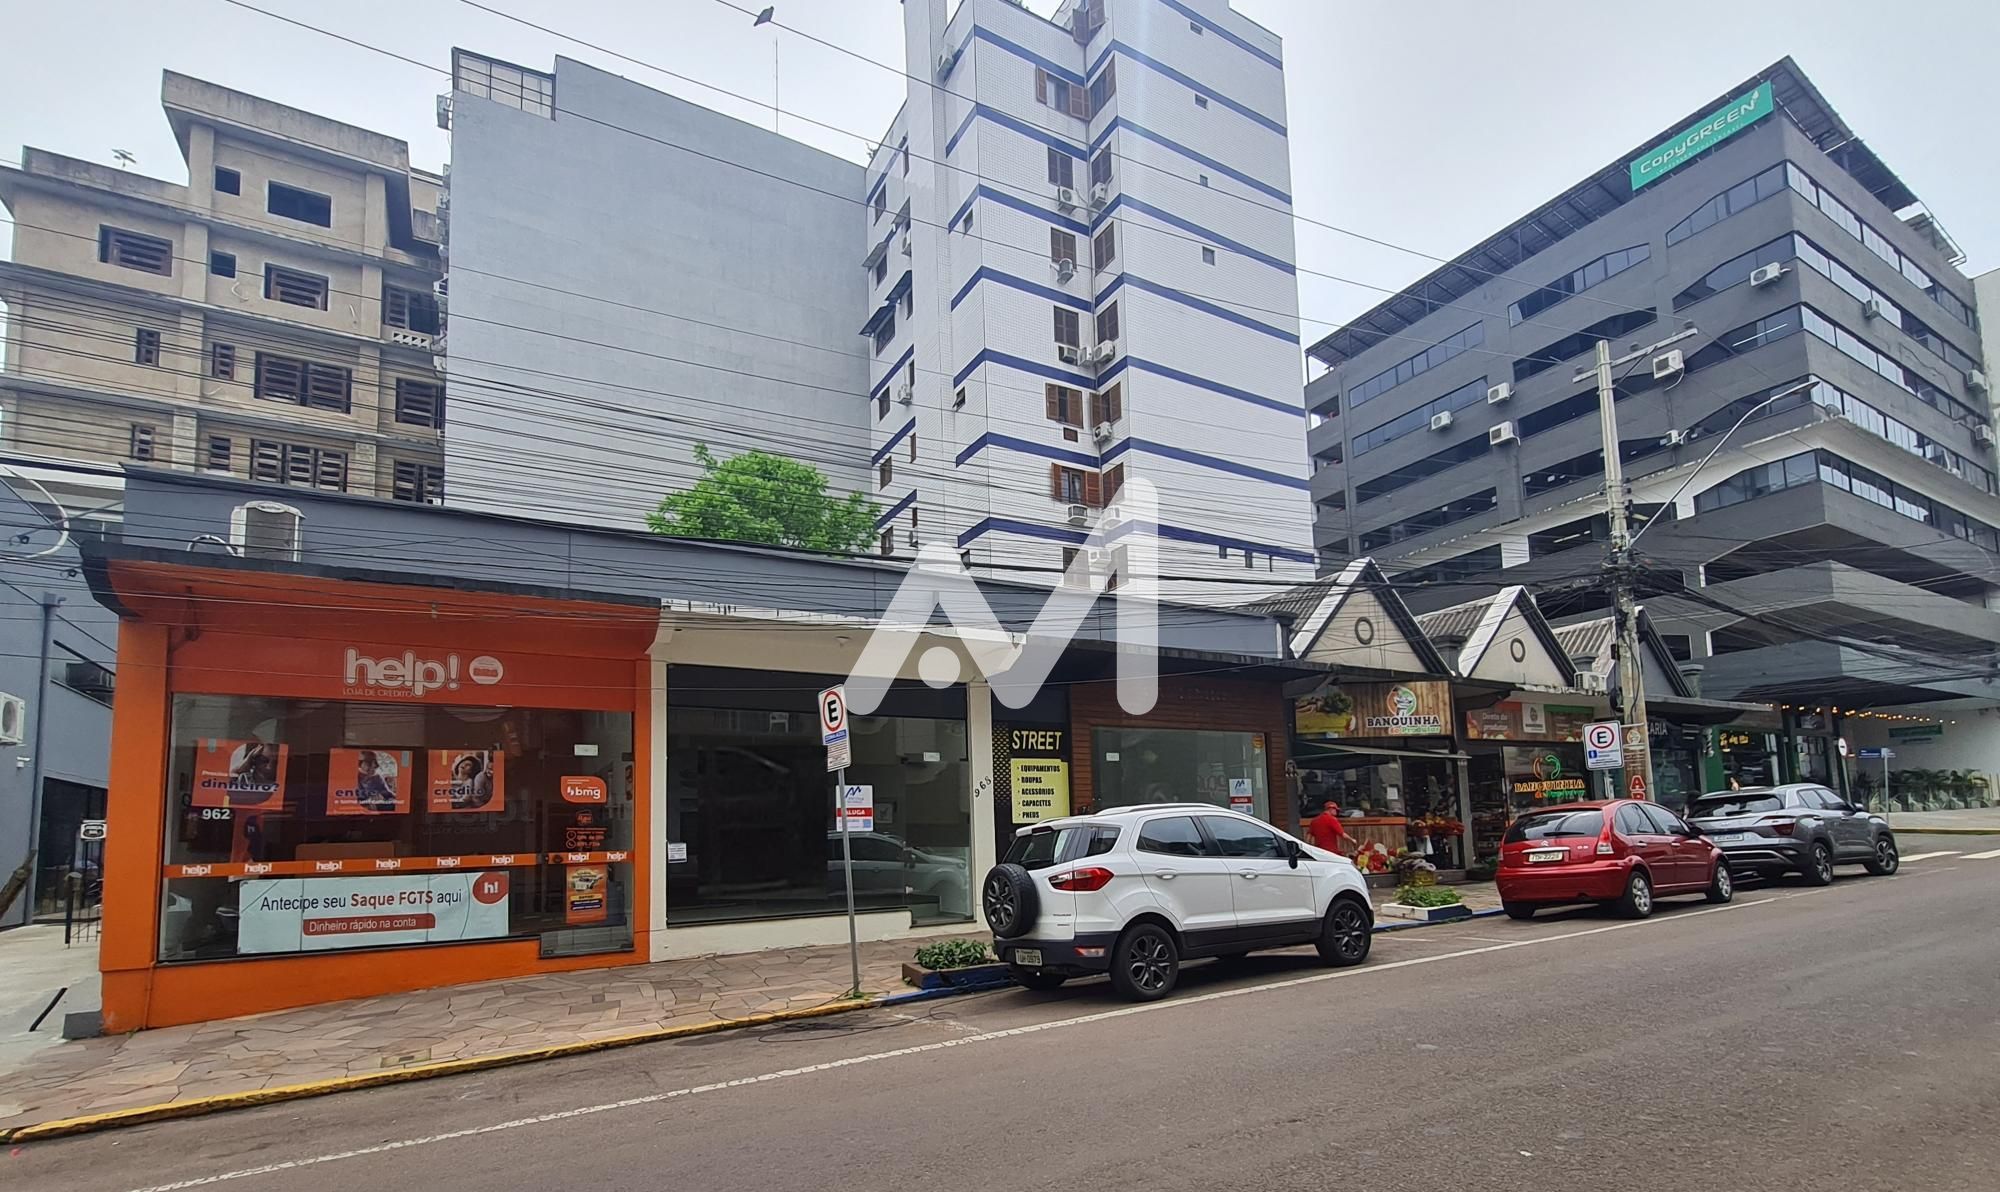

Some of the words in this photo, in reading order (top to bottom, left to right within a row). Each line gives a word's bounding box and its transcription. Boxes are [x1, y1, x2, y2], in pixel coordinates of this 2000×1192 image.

[1640, 98, 1758, 174] CopyGREEN
[344, 648, 460, 696] help!
[827, 700, 838, 723] E
[1367, 716, 1439, 728] BANQUINHA
[1012, 730, 1062, 750] STREET
[1597, 731, 1608, 744] E
[1020, 765, 1061, 773] EQUIPAMENTOS
[201, 778, 280, 793] dinheiro?
[575, 787, 601, 799] bmg
[1022, 799, 1052, 808] CAPACETES
[202, 808, 231, 820] 962
[1022, 811, 1040, 819] PNEUS
[437, 857, 460, 868] help!
[491, 855, 515, 866] help!
[568, 852, 590, 863] help!
[606, 851, 628, 862] help!
[182, 864, 211, 876] help!
[244, 863, 273, 874] help!
[316, 861, 343, 873] help!
[376, 859, 401, 870] help!
[484, 881, 499, 894] h!
[260, 896, 319, 911] Antecipe
[323, 895, 347, 908] seu
[351, 893, 395, 910] Saque
[399, 890, 433, 906] FGTS
[437, 889, 462, 906] aqui
[309, 920, 348, 933] Dinheiro
[350, 918, 377, 932] rápido
[379, 920, 391, 929] na
[393, 918, 417, 929] conta
